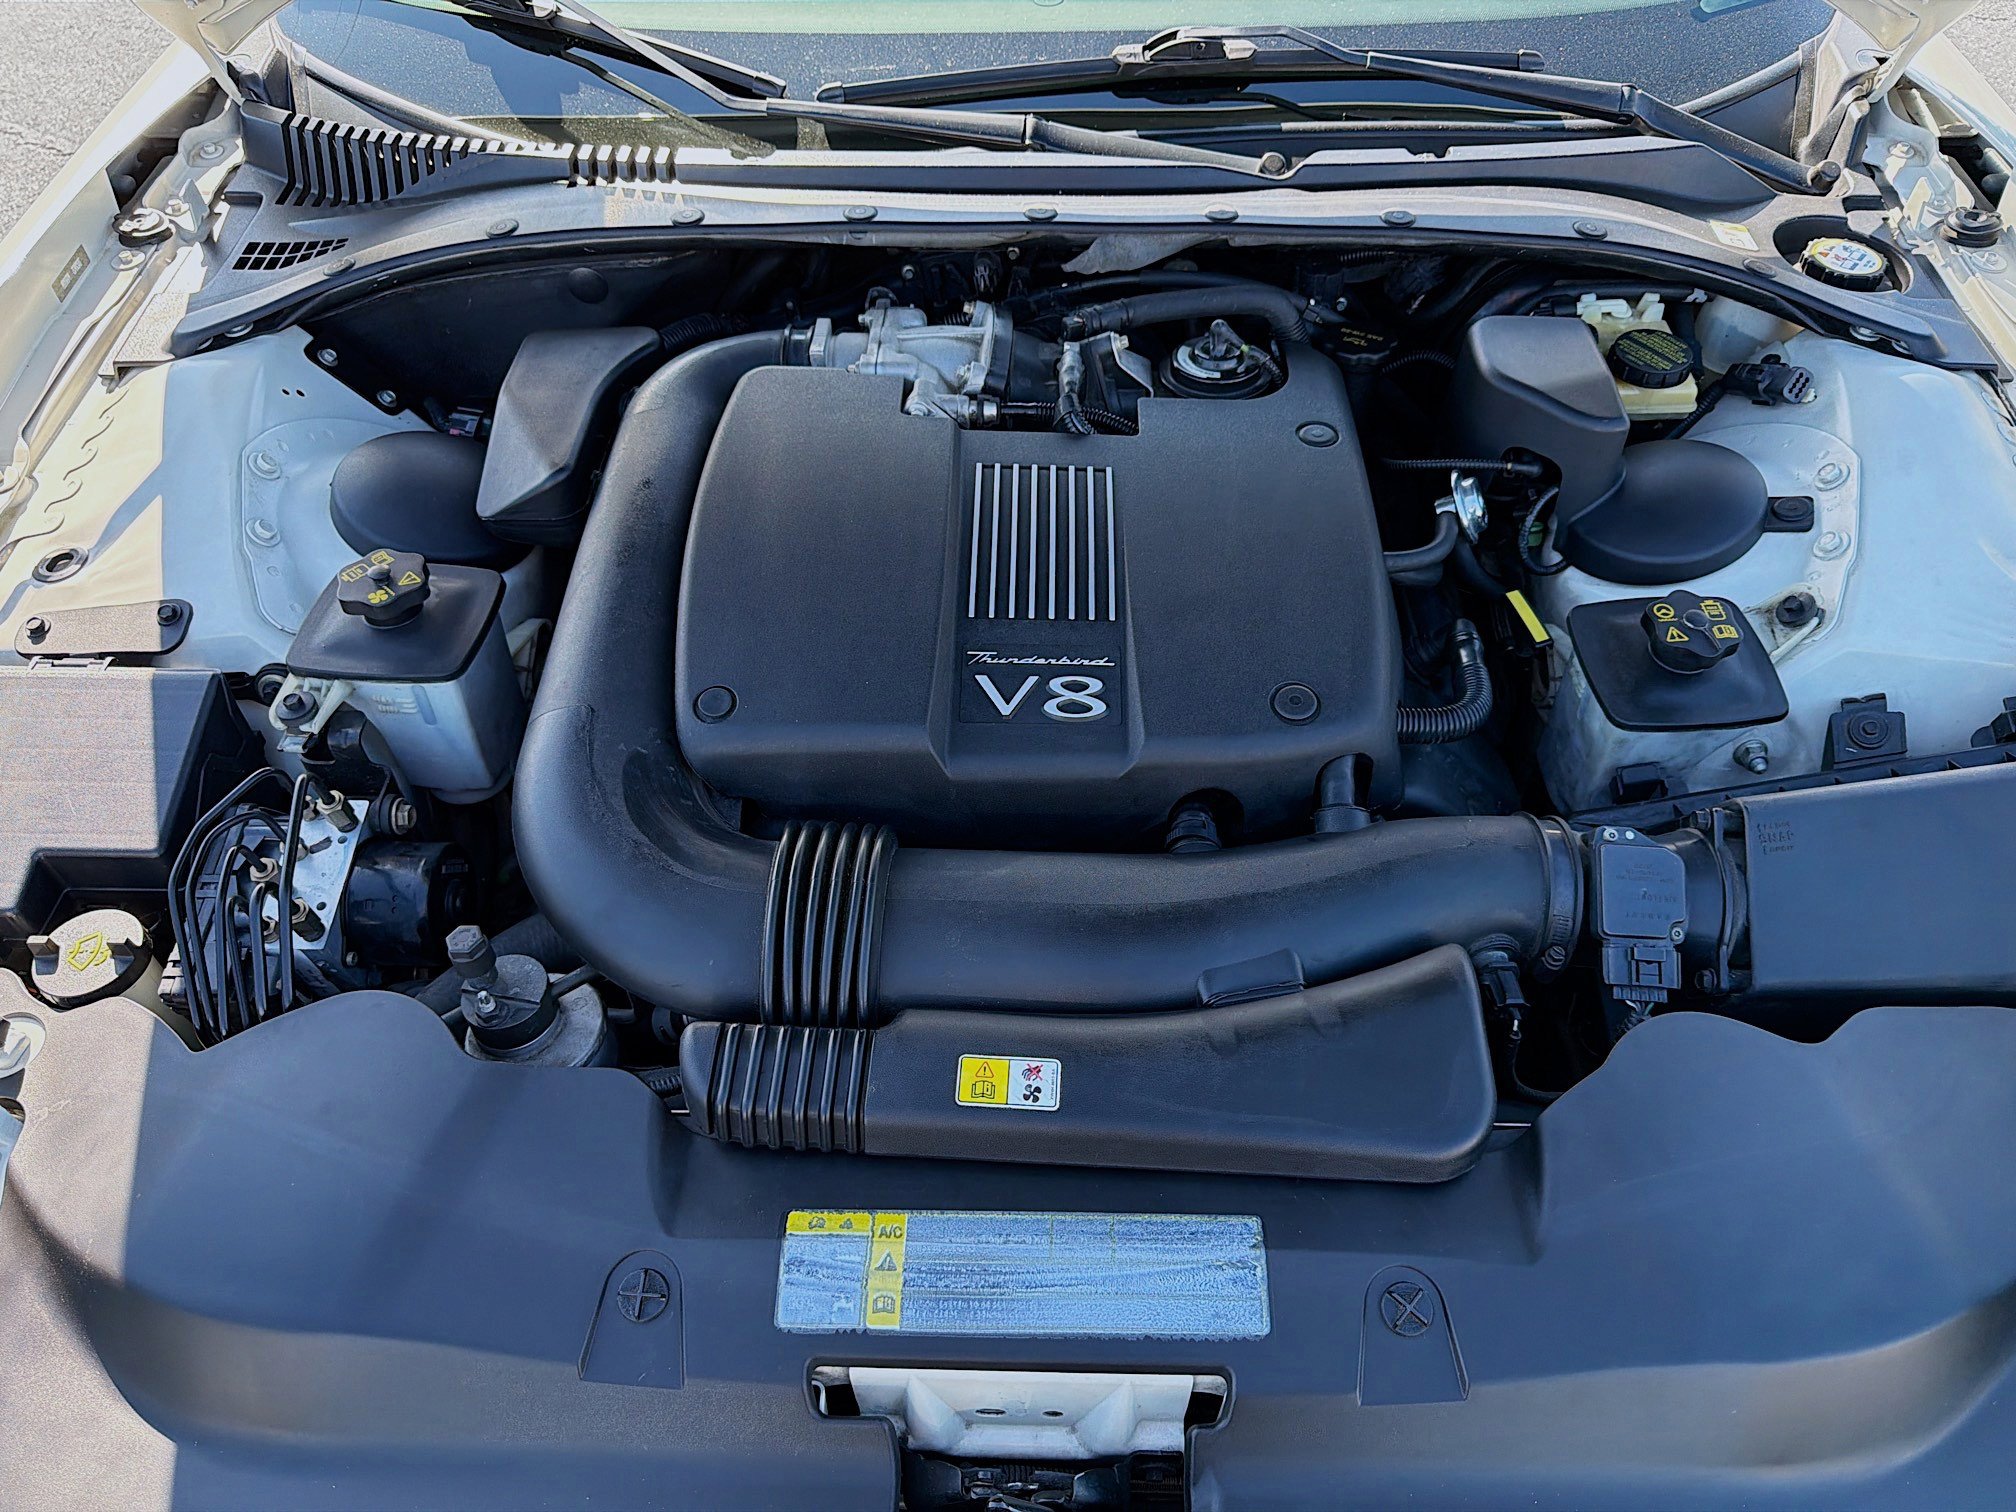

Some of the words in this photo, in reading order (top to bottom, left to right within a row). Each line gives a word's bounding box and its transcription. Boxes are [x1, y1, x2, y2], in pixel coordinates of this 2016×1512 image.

[966, 651, 1116, 666] Thunderbird
[974, 674, 1108, 720] V8
[878, 1224, 903, 1239] A/C
